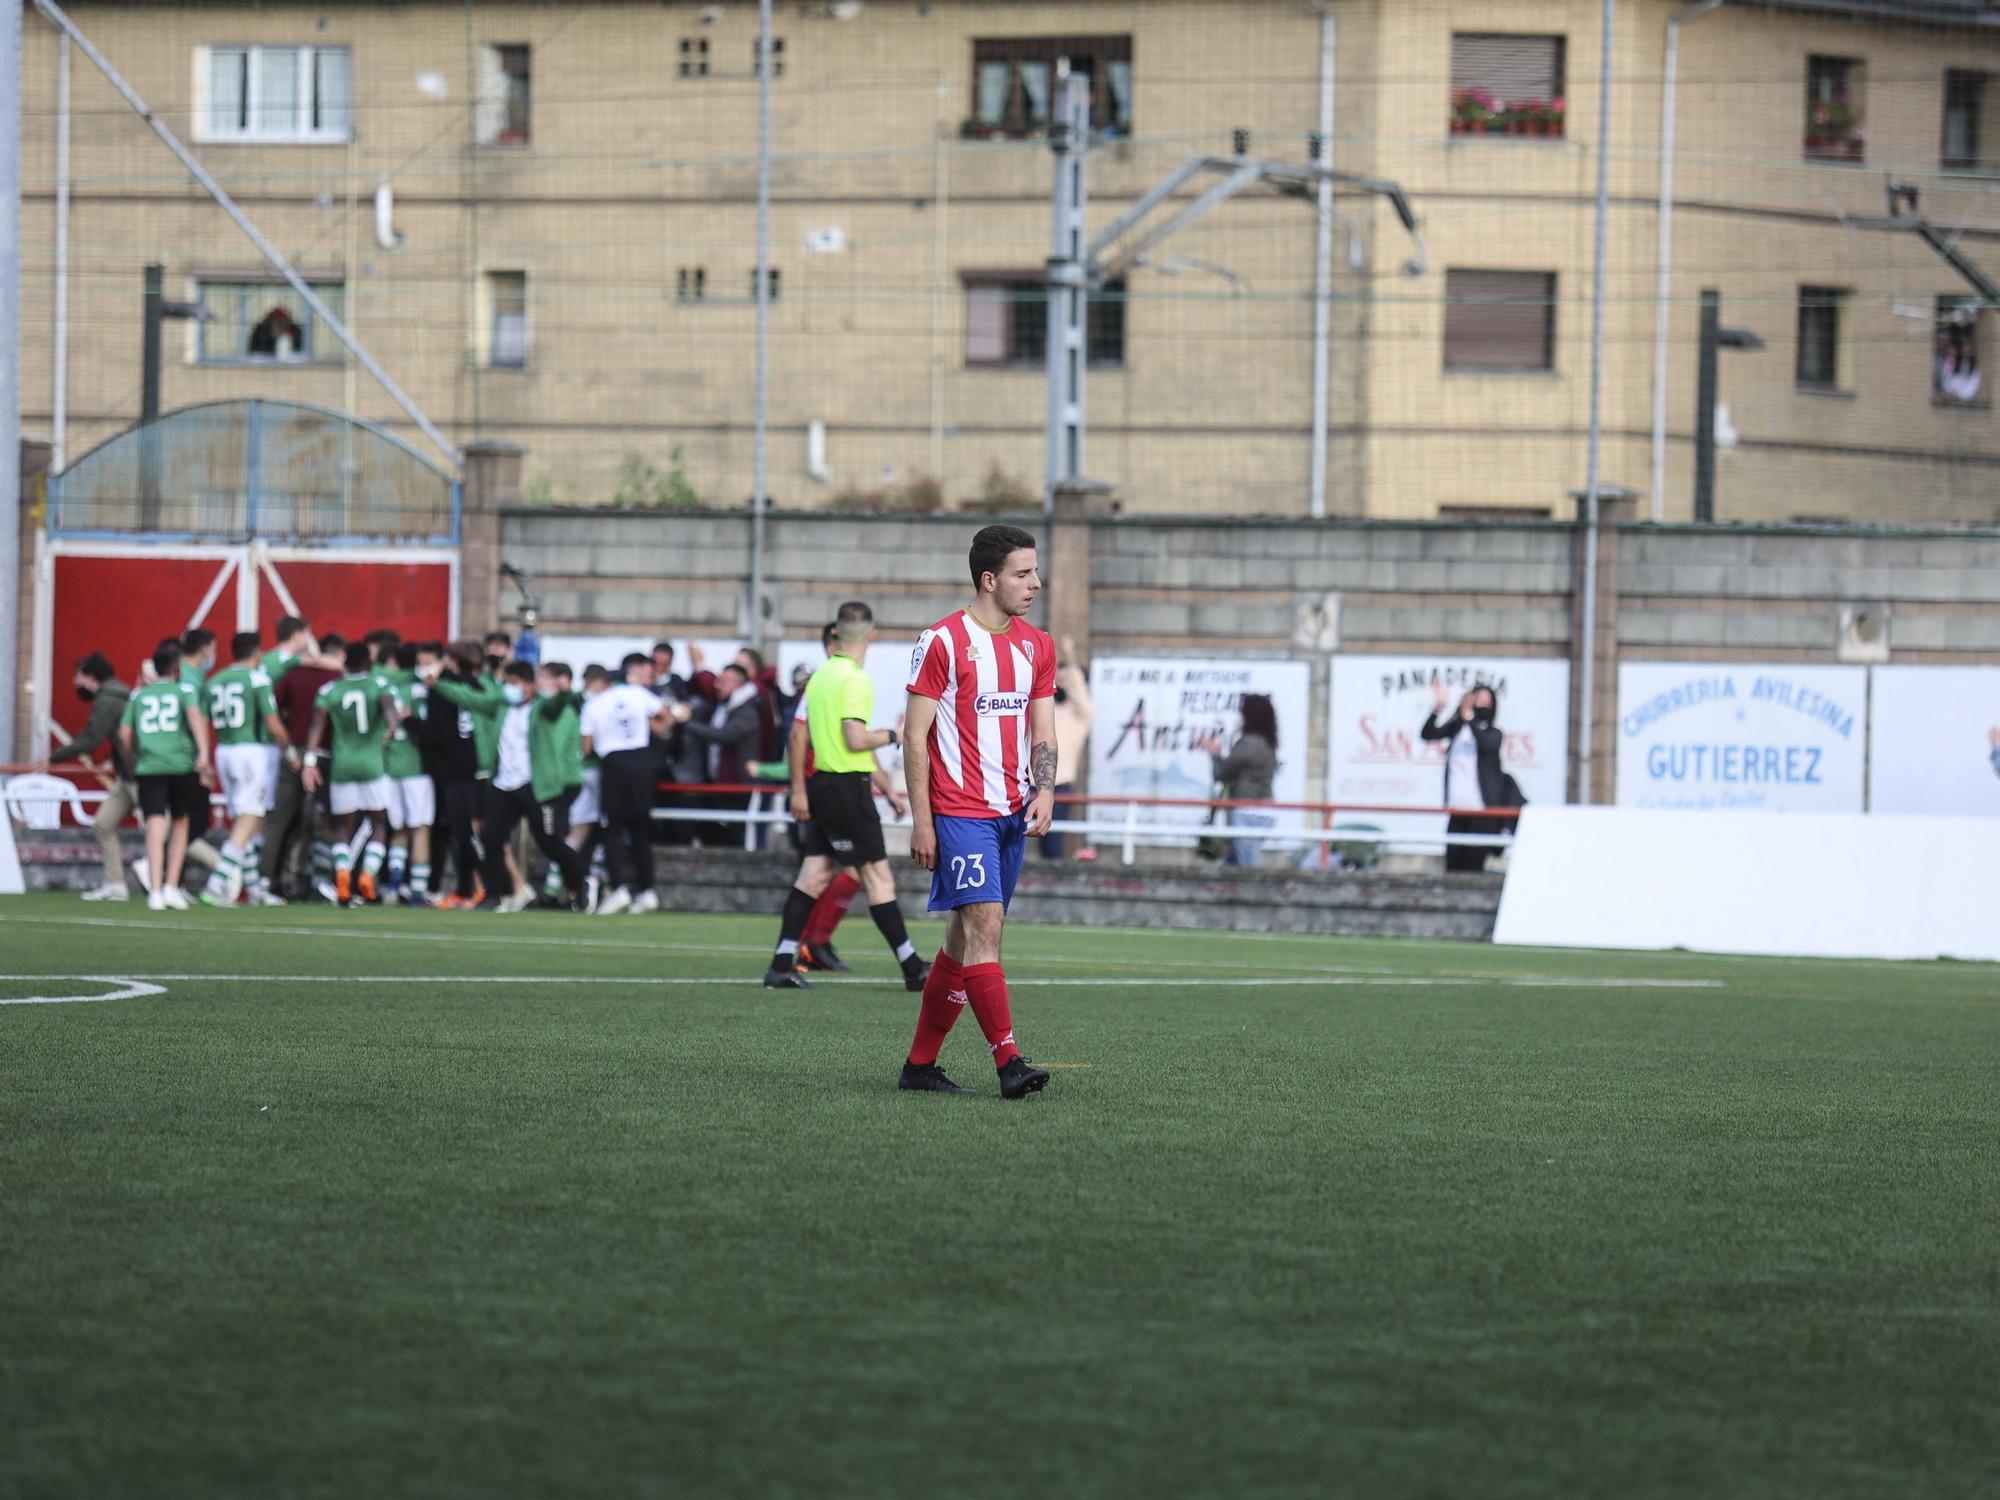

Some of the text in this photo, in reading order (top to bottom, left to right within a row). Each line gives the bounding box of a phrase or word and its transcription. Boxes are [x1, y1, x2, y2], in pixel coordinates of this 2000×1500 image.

[140, 693, 180, 734] 22
[342, 690, 369, 734] 7
[1752, 676, 1855, 739] AVILESINA
[1647, 744, 1822, 783] GUTIERREZ
[951, 853, 986, 890] 23
